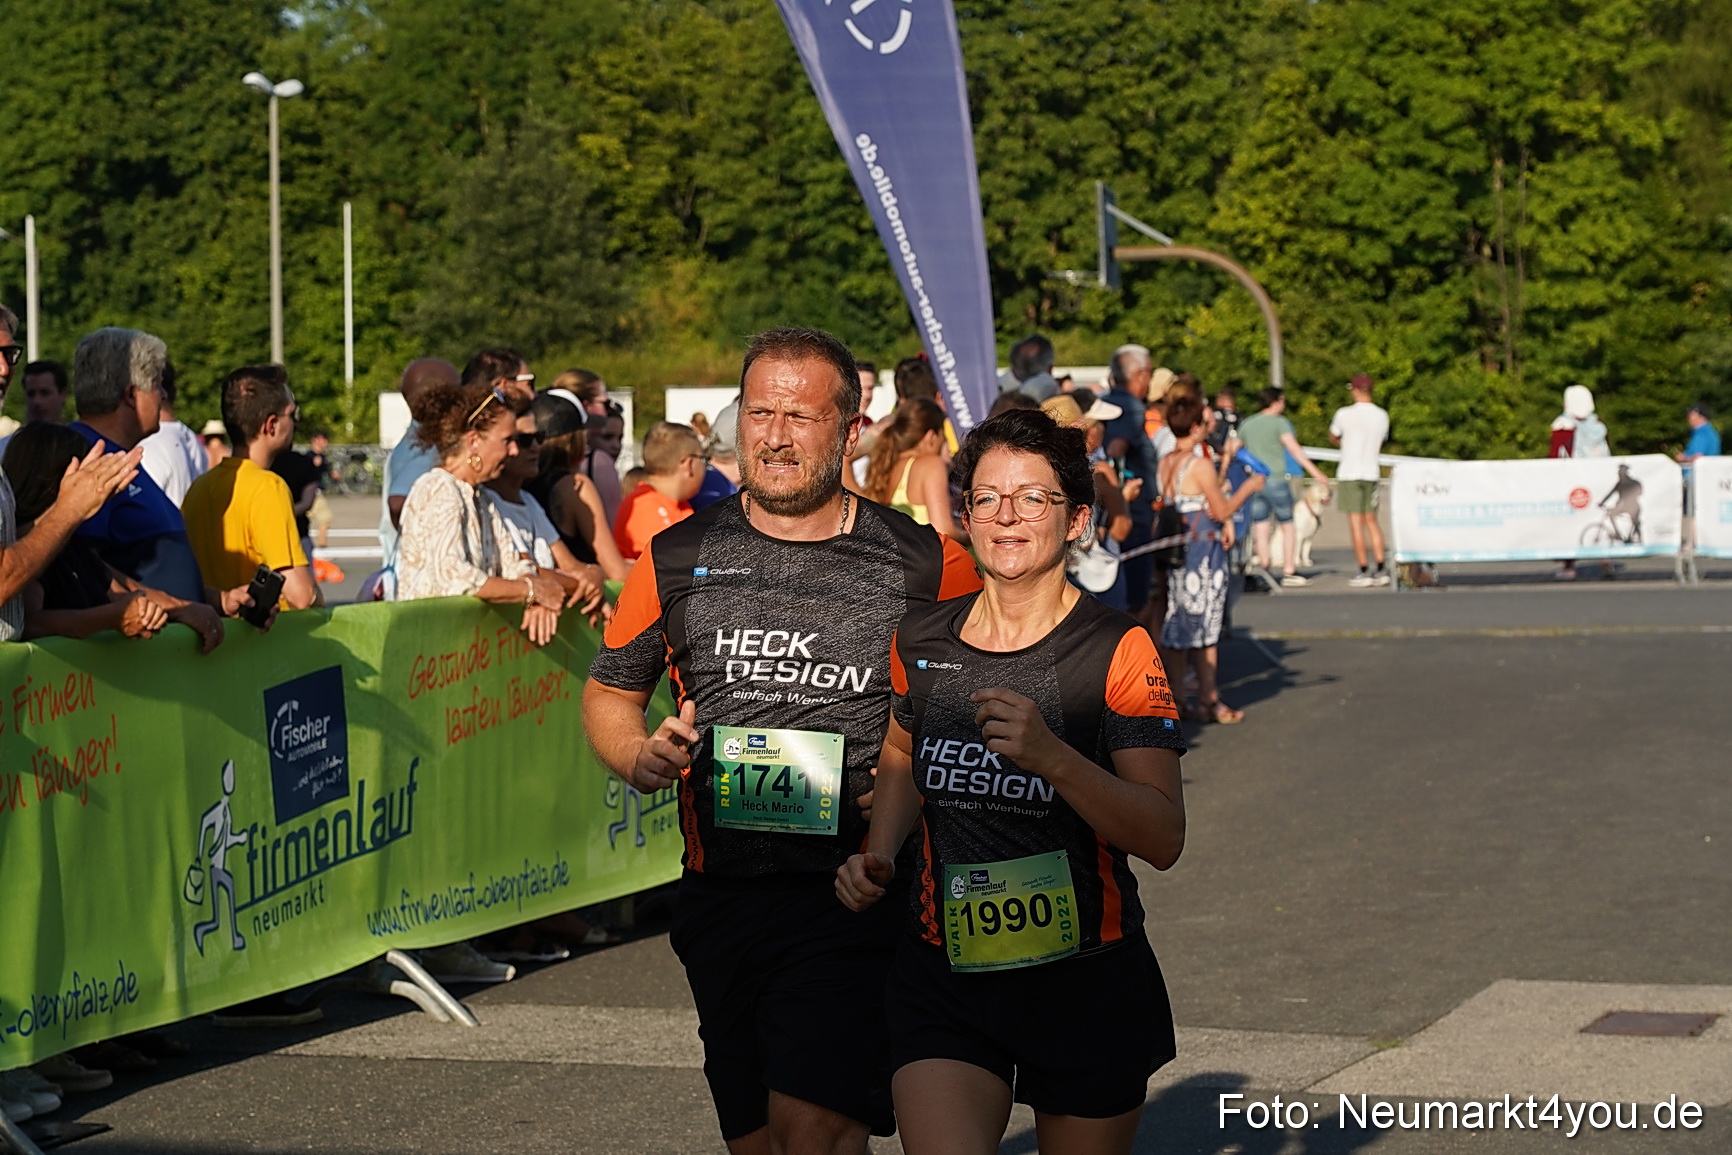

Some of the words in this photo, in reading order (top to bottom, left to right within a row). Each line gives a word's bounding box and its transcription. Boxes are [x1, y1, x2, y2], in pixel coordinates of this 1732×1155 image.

[408, 626, 491, 699] Gesunde
[714, 629, 819, 658] HECK
[446, 685, 502, 746] laufen
[507, 651, 570, 726] länger!
[725, 660, 872, 693] DESIGN
[13, 673, 96, 734] Firmen
[281, 714, 331, 750] Fischer
[919, 737, 1003, 769] HECK
[32, 714, 122, 807] länger!
[733, 763, 812, 799] 1741
[720, 773, 730, 807] RUN
[819, 773, 833, 820] 2022
[925, 765, 1055, 802] DESIGN
[742, 800, 768, 812] Heck
[771, 802, 804, 814] Mario
[986, 801, 1050, 819] Werbung!
[247, 757, 420, 902] firmenlauf
[253, 879, 325, 936] neumarkt
[366, 850, 570, 937] www.firmenlauf-oberpfalz.de
[966, 880, 1006, 893] Firmenlauf
[950, 907, 961, 957] WALK
[960, 893, 1053, 937] 1990
[1055, 894, 1073, 943] 2022
